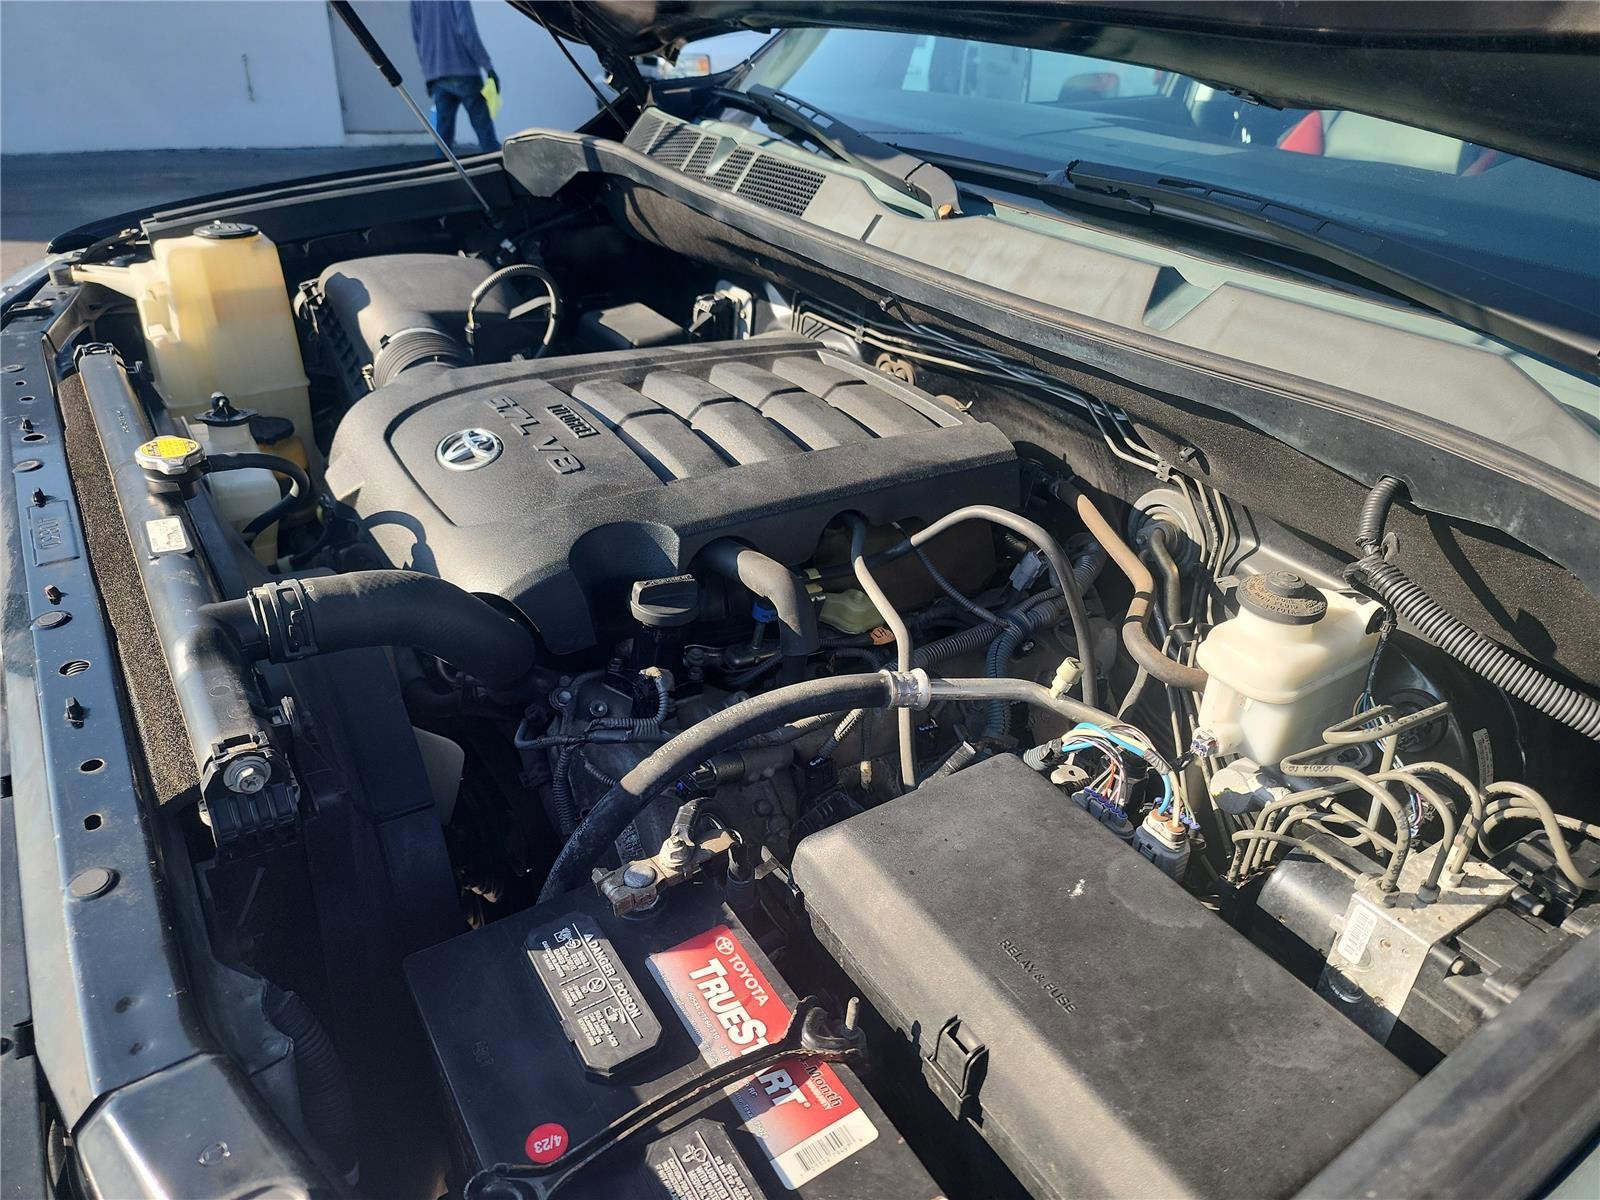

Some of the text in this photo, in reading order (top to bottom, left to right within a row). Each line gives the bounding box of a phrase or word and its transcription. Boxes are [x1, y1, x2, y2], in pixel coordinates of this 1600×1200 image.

[532, 434, 586, 475] V8
[872, 629, 886, 638] LH
[587, 940, 617, 977] DANGER
[613, 981, 642, 1019] POISON
[729, 955, 769, 1007] TOYOTA
[999, 939, 1078, 1014] RELAY & FUSE
[593, 1009, 618, 1047] SULFURIC ACID
[532, 1134, 563, 1154] 4/23
[687, 1169, 707, 1199] MEDICAL
[694, 1165, 709, 1184] WITH
[702, 1160, 728, 1199] FLUSH EYES
[719, 1164, 729, 1176] NOT
[726, 1162, 738, 1177] KEEP
[734, 1176, 745, 1188] OUT
